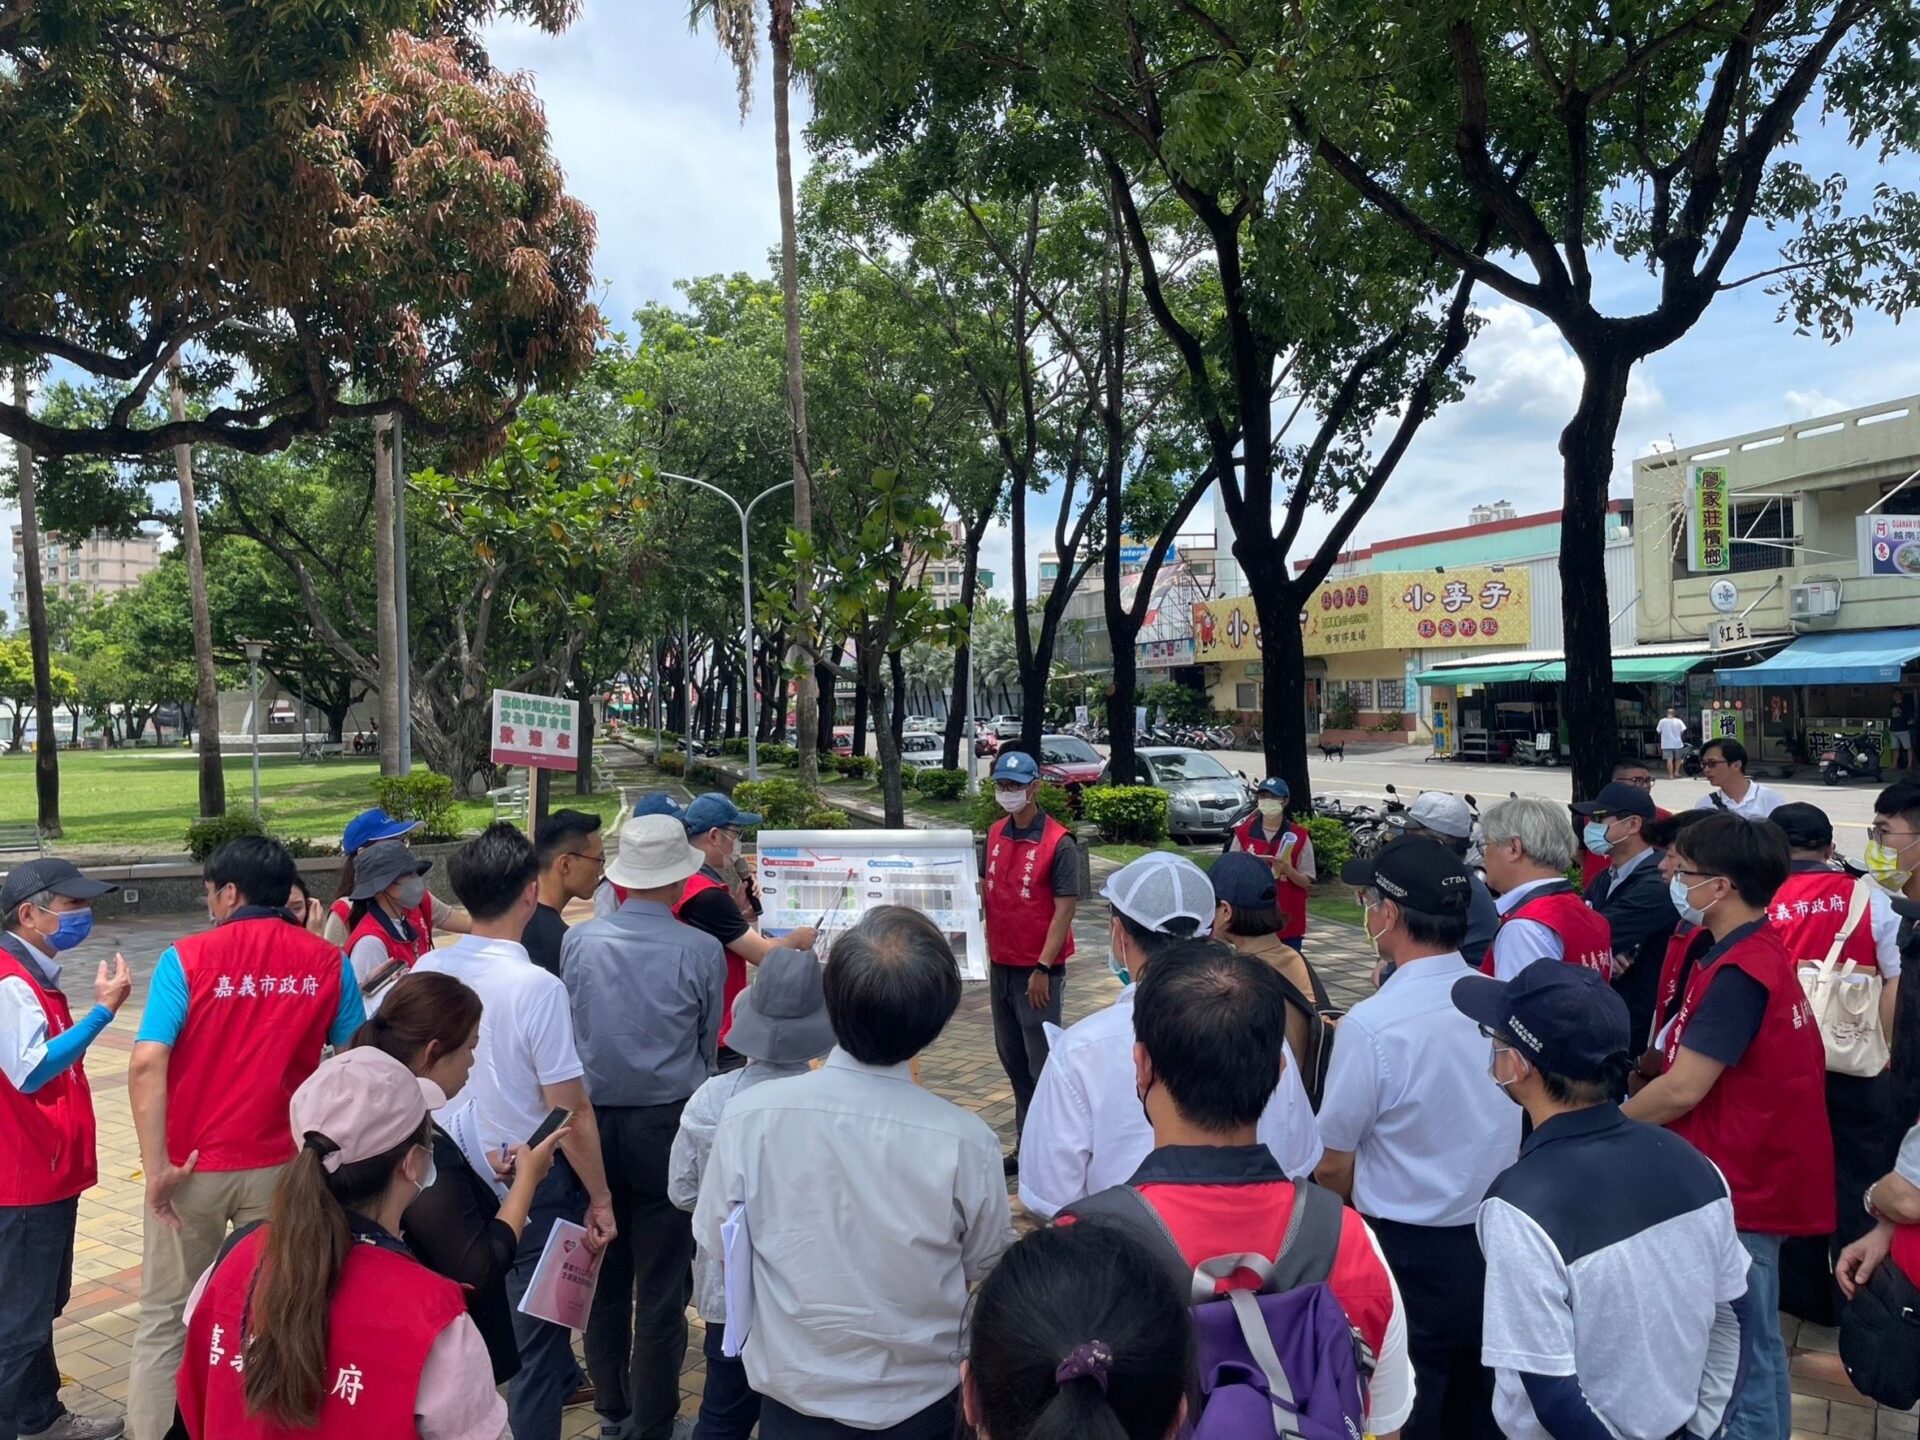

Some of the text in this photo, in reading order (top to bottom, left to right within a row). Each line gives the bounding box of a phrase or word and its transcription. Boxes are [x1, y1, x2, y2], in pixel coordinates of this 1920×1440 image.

[1702, 471, 1723, 567] 廖家莊檳榔
[1419, 618, 1499, 638] 美食料理
[1442, 875, 1467, 886] CTBA
[1765, 893, 1845, 921] 義市政府
[213, 974, 320, 998] 嘉義市政府
